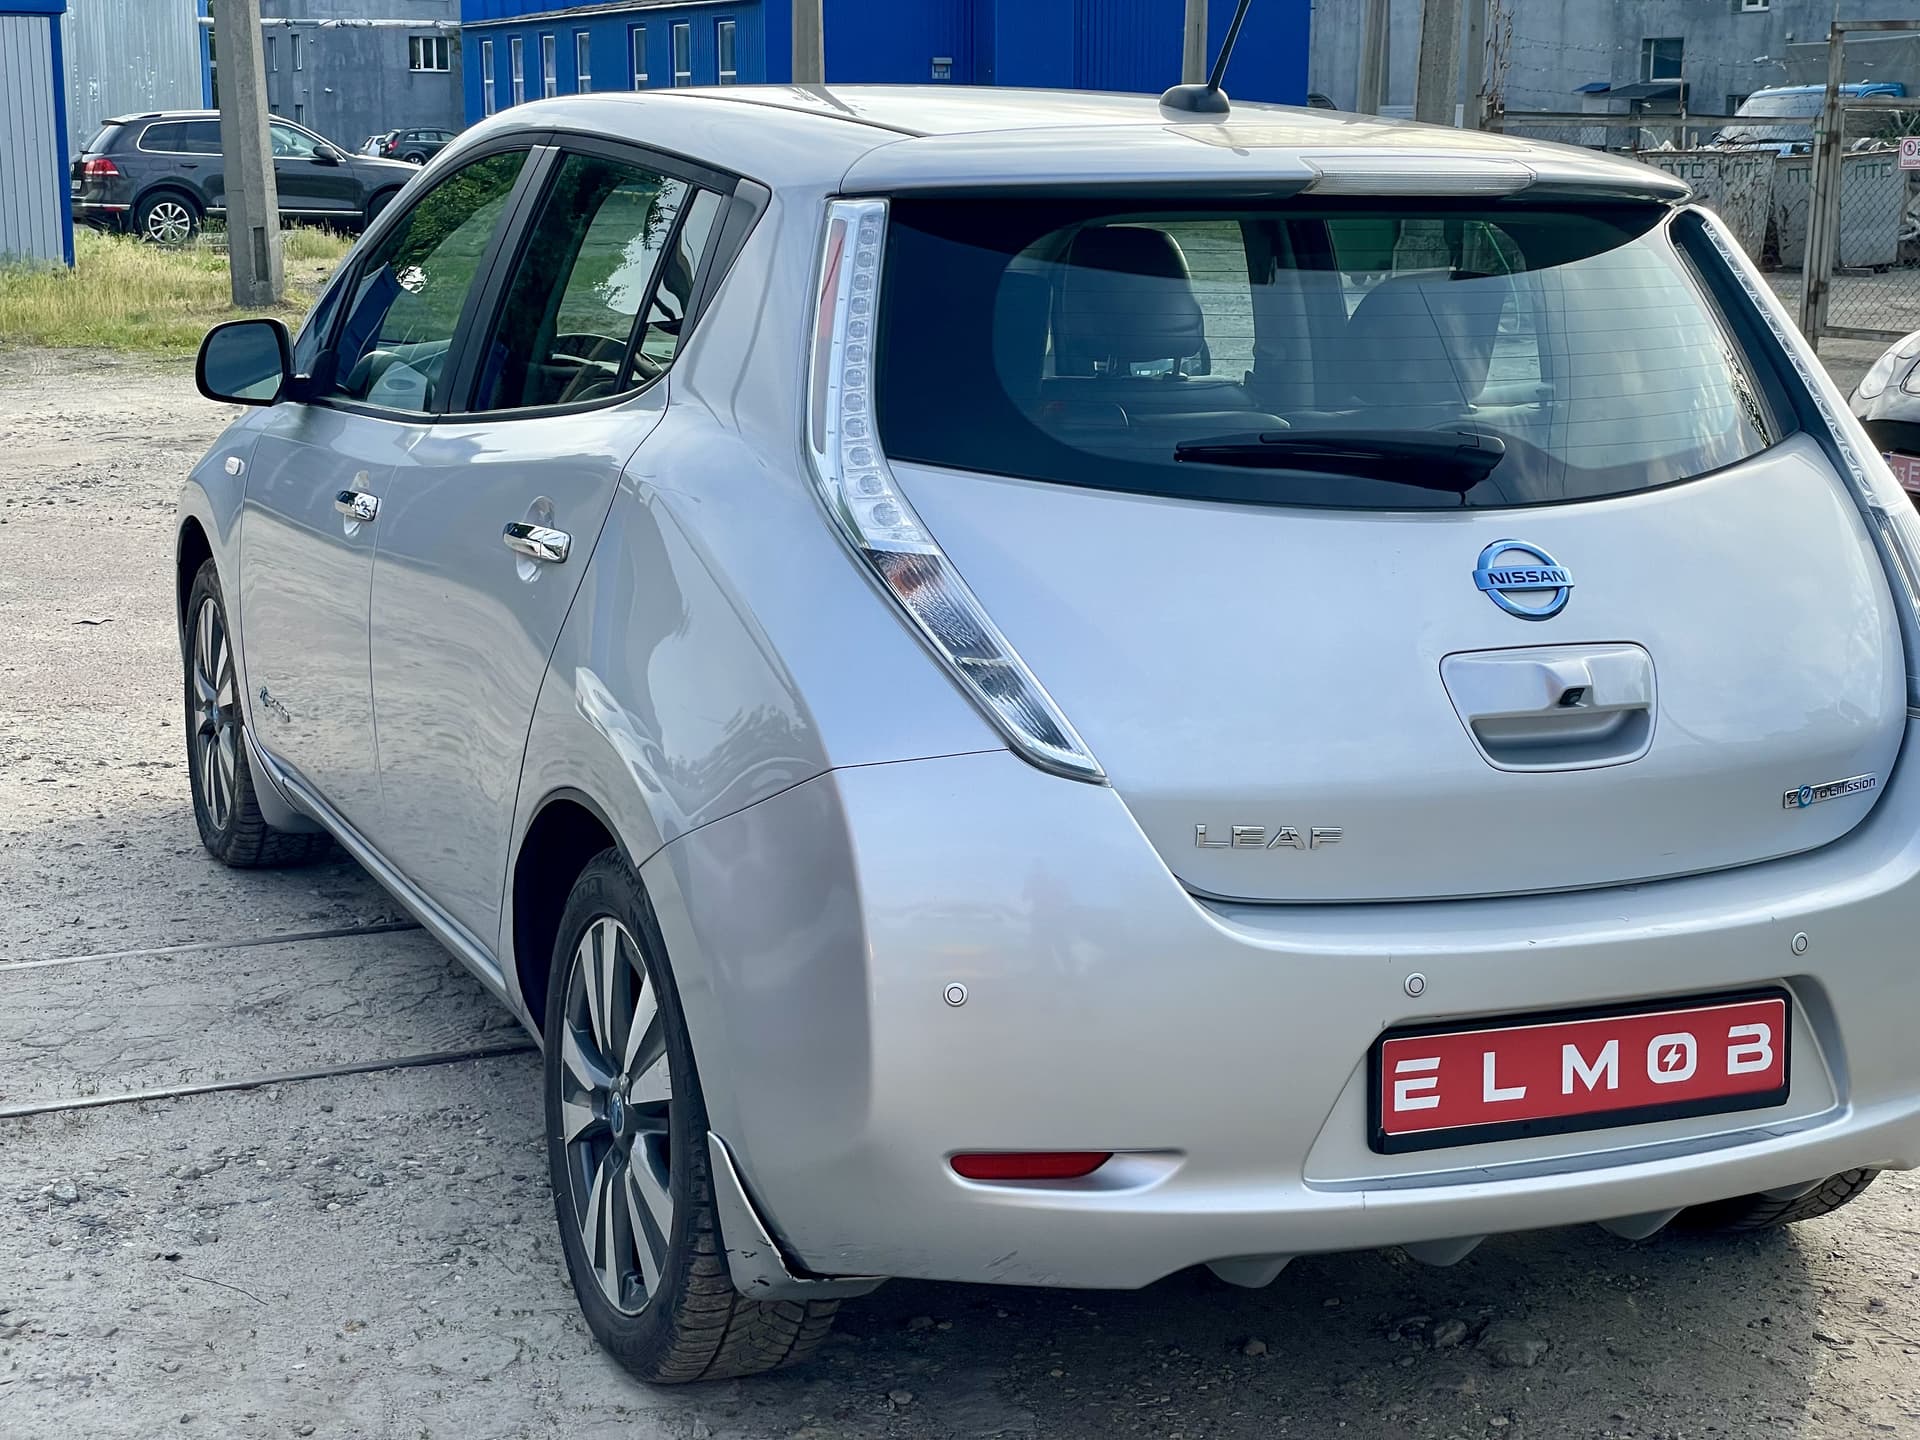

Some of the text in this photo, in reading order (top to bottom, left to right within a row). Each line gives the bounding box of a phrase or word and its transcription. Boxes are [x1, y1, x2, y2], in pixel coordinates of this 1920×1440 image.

[1787, 167, 1812, 183] ПТ
[1487, 570, 1567, 585] NISSAN
[1195, 824, 1343, 849] LEAF
[1394, 1022, 1773, 1112] ELMOB
